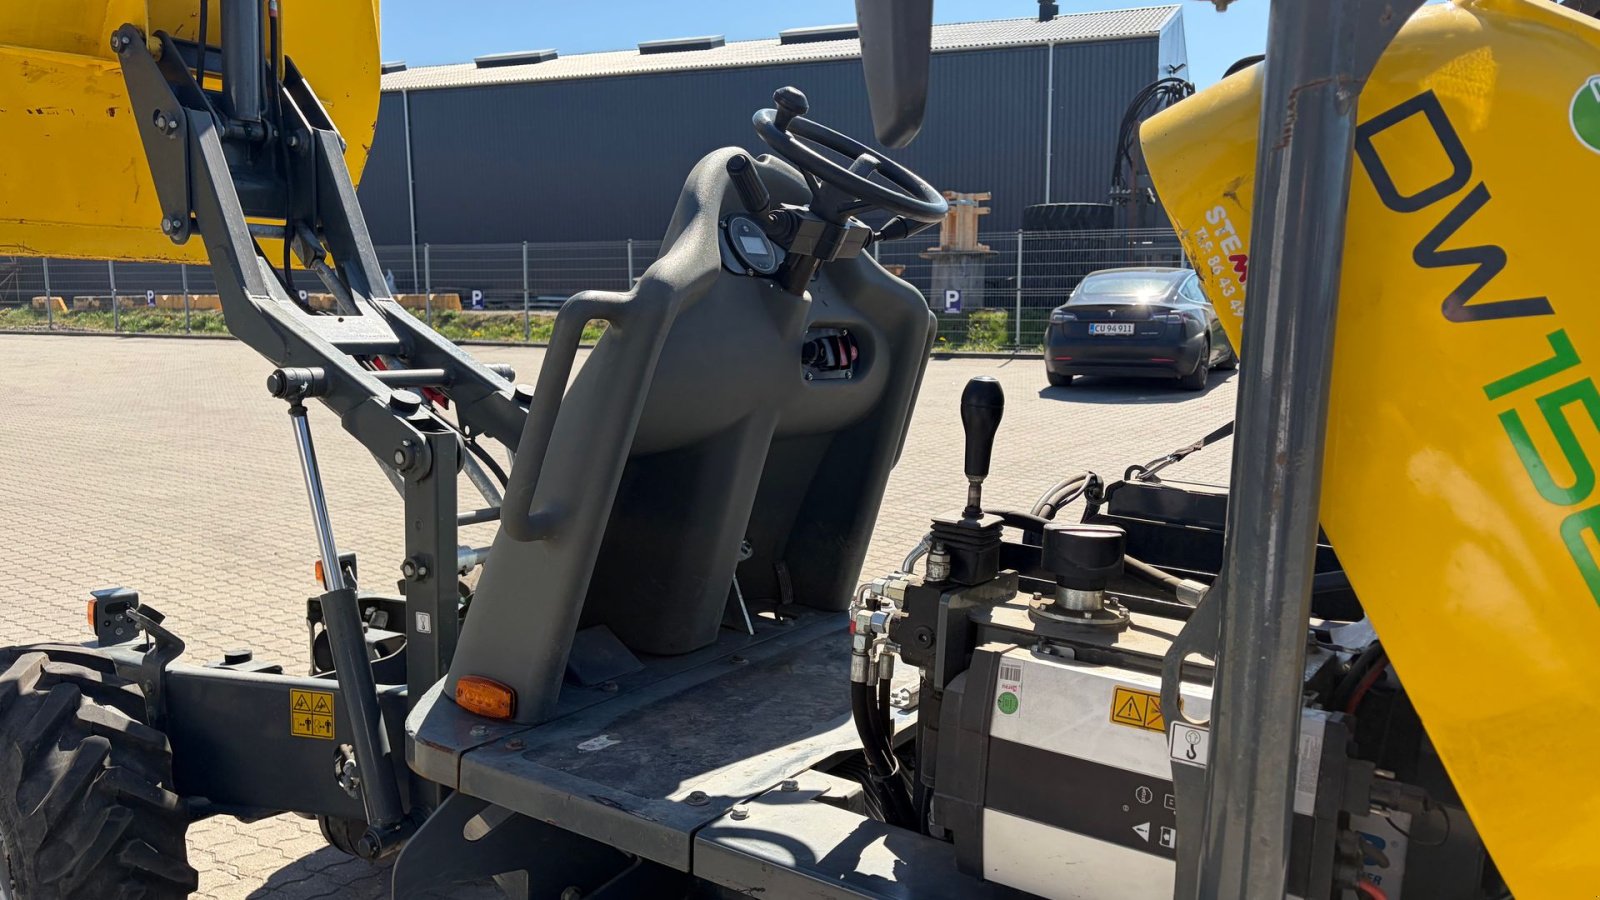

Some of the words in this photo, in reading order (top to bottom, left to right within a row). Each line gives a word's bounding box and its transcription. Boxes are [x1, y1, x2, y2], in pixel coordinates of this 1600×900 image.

[1205, 205, 1248, 291] STEM
[1207, 255, 1224, 275] 86
[1219, 278, 1236, 297] 43
[147, 290, 154, 303] P
[471, 290, 482, 305] P
[946, 290, 960, 308] P
[1095, 324, 1105, 332] CU
[1119, 324, 1132, 332] 911
